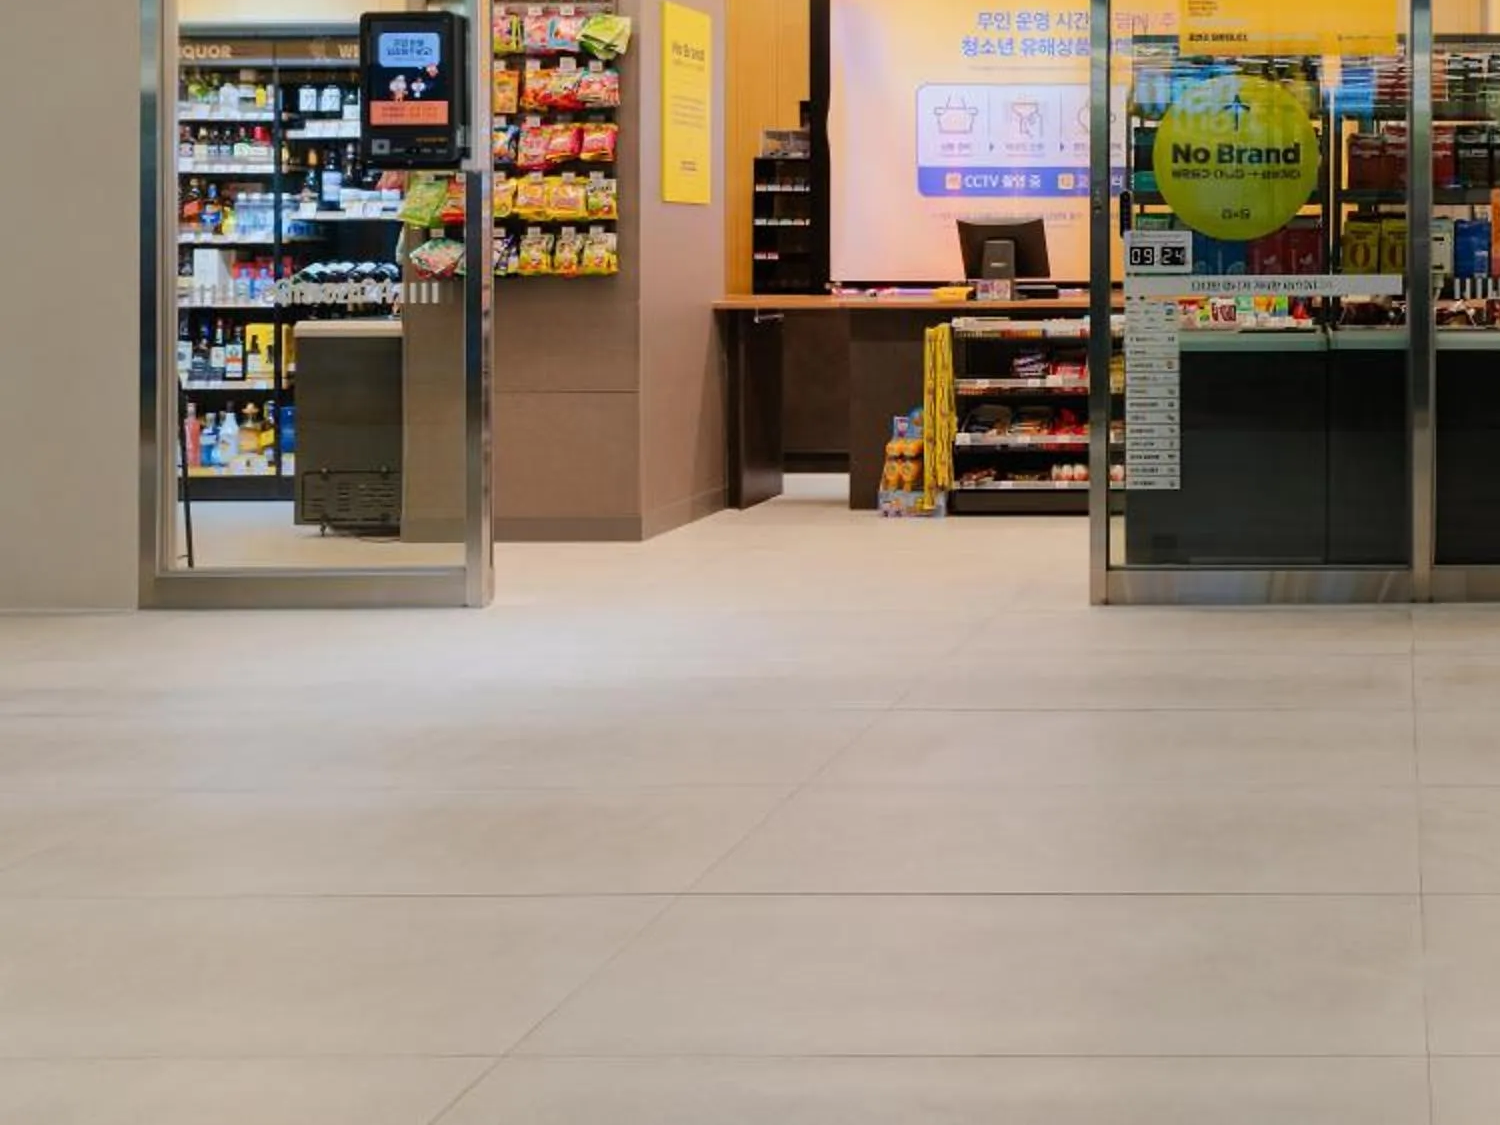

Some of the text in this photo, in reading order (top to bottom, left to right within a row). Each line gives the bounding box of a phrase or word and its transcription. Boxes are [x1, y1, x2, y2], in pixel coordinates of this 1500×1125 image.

[978, 12, 1011, 31] 무인
[1016, 11, 1050, 31] 운영
[181, 44, 232, 59] QUOR
[962, 35, 1014, 57] 청소년
[1171, 142, 1301, 164] No Brand
[964, 174, 1000, 189] CCTV
[1131, 248, 1153, 264] 09
